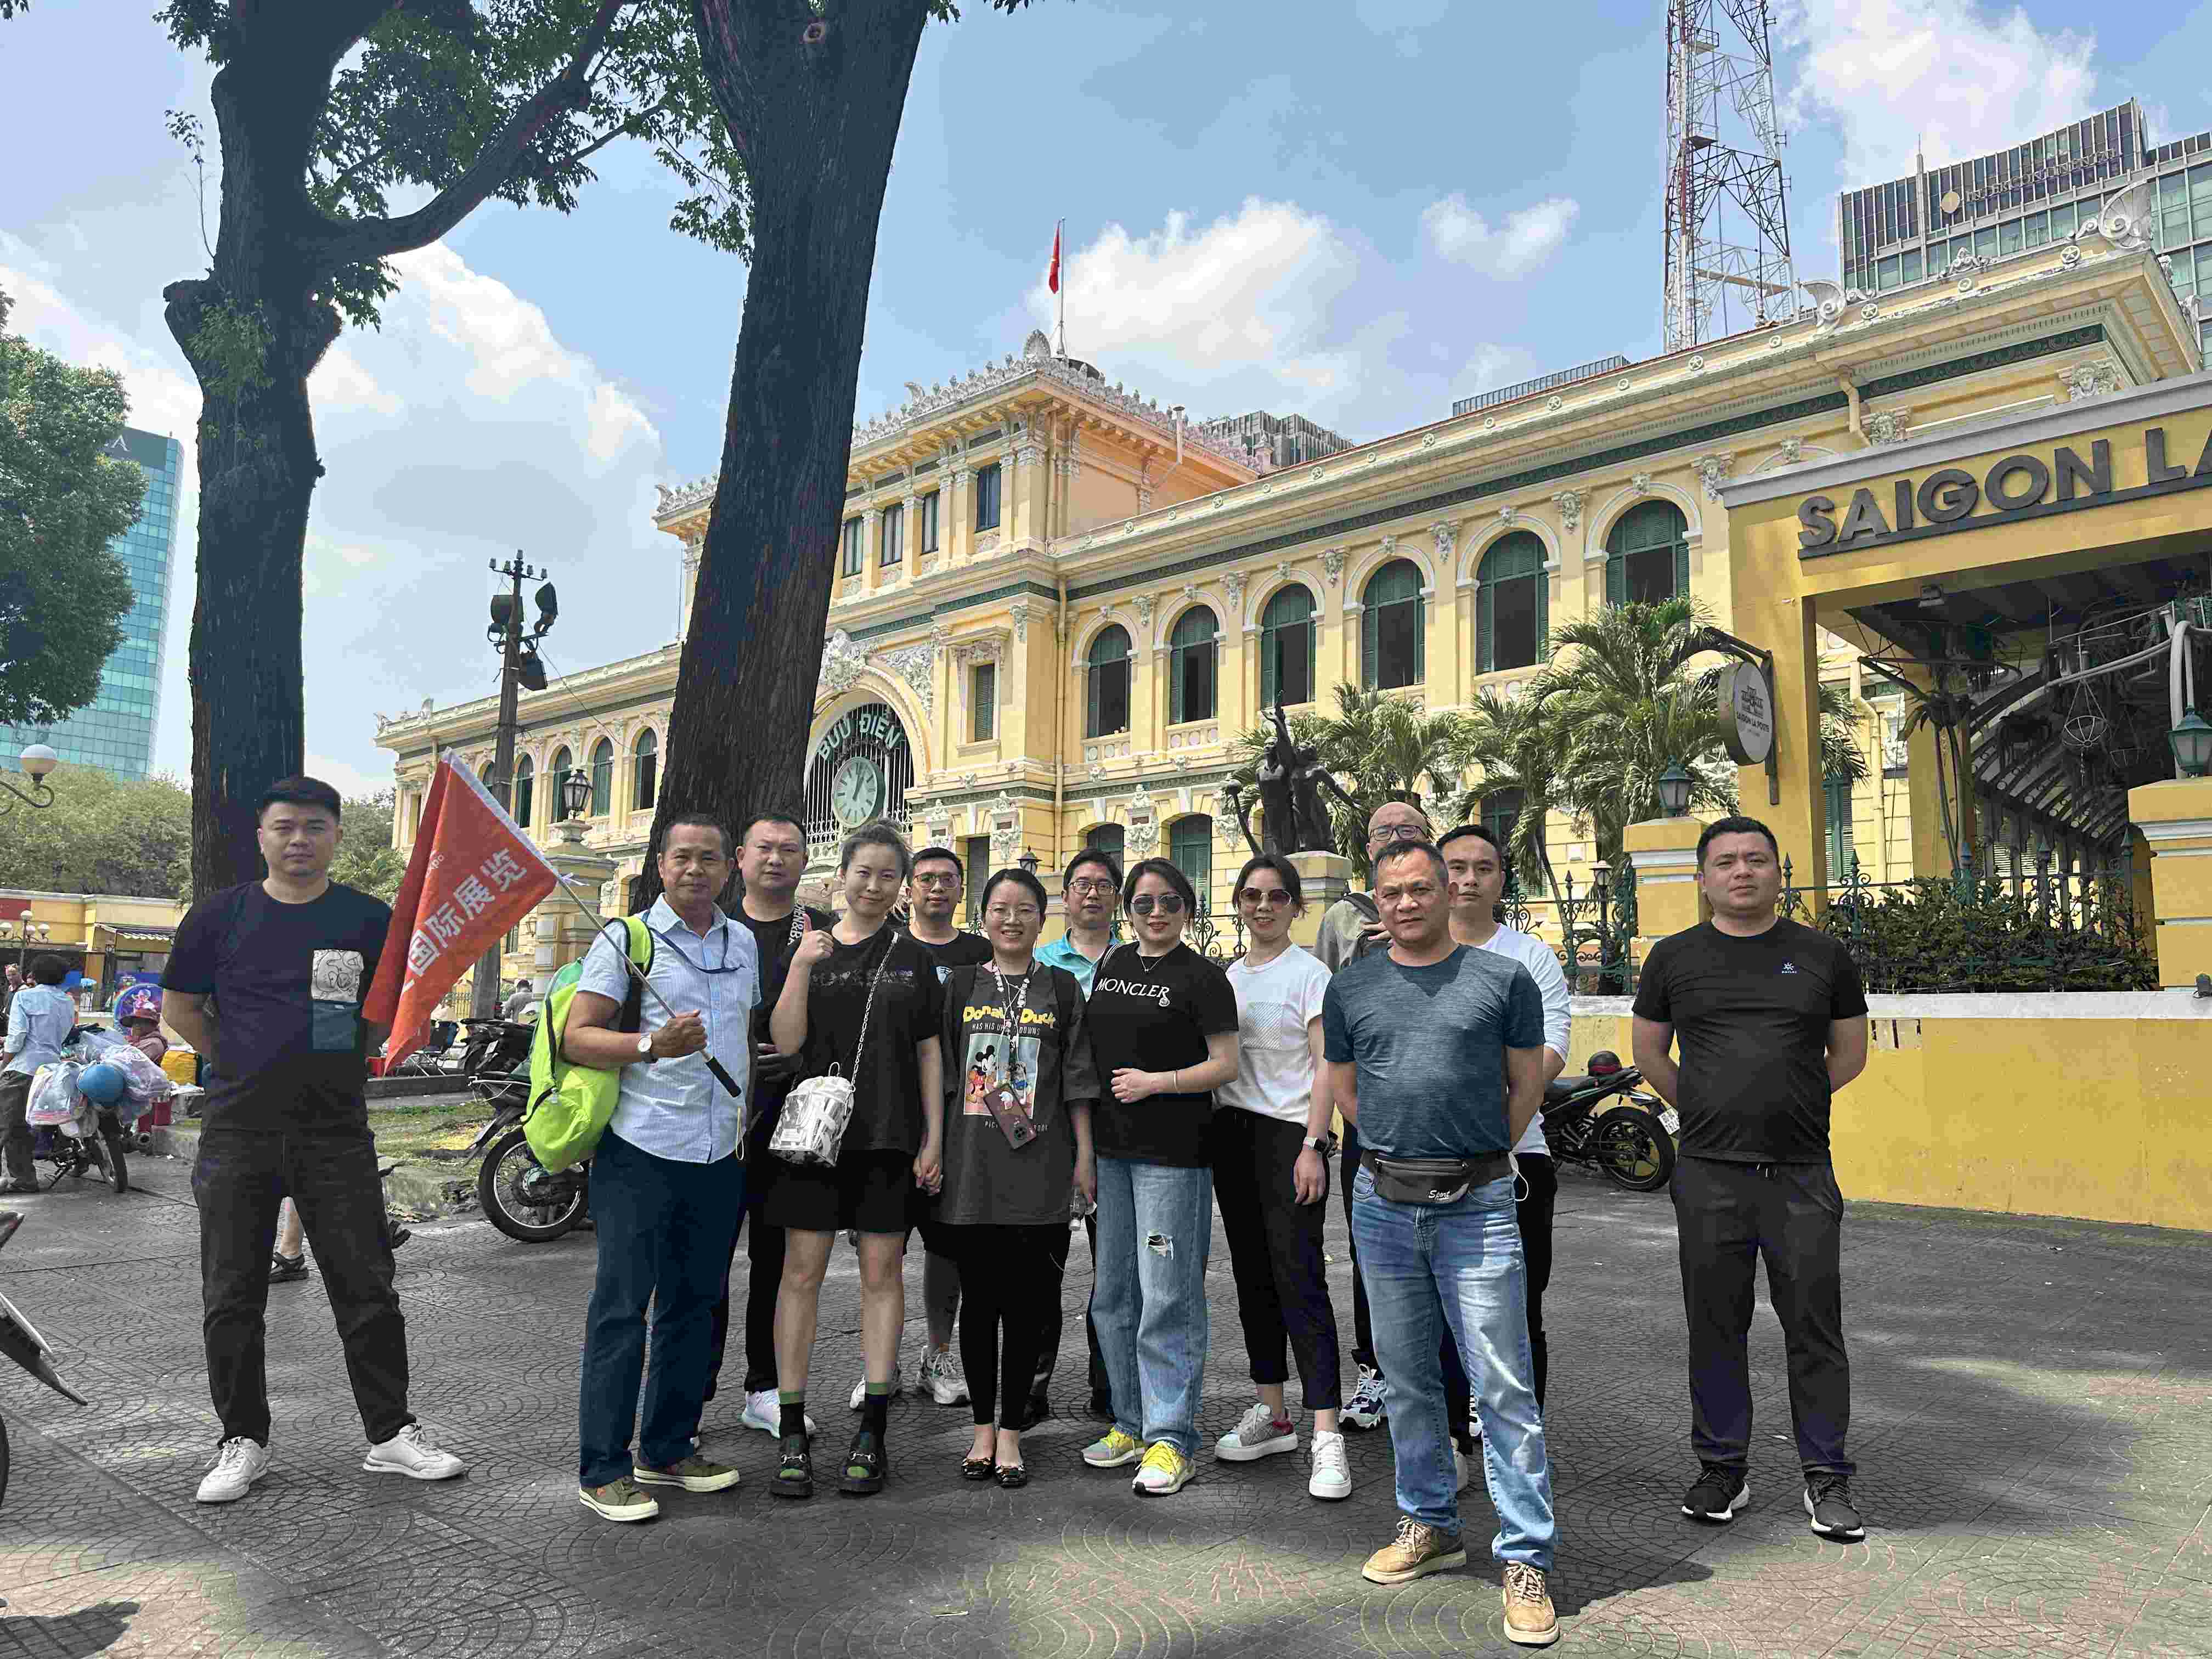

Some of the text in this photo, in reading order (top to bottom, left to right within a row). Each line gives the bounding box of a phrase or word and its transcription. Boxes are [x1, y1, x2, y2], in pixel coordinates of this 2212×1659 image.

[1798, 439, 2112, 546] SAIGON
[408, 848, 527, 977] 国际展览
[1095, 977, 1170, 998] MONCLER
[971, 1022, 983, 1031] HAS
[985, 1022, 995, 1030] HIS
[1019, 1026, 1041, 1036] DOWNS
[1019, 1008, 1056, 1029] Duck
[1428, 1189, 1451, 1199] Sport
